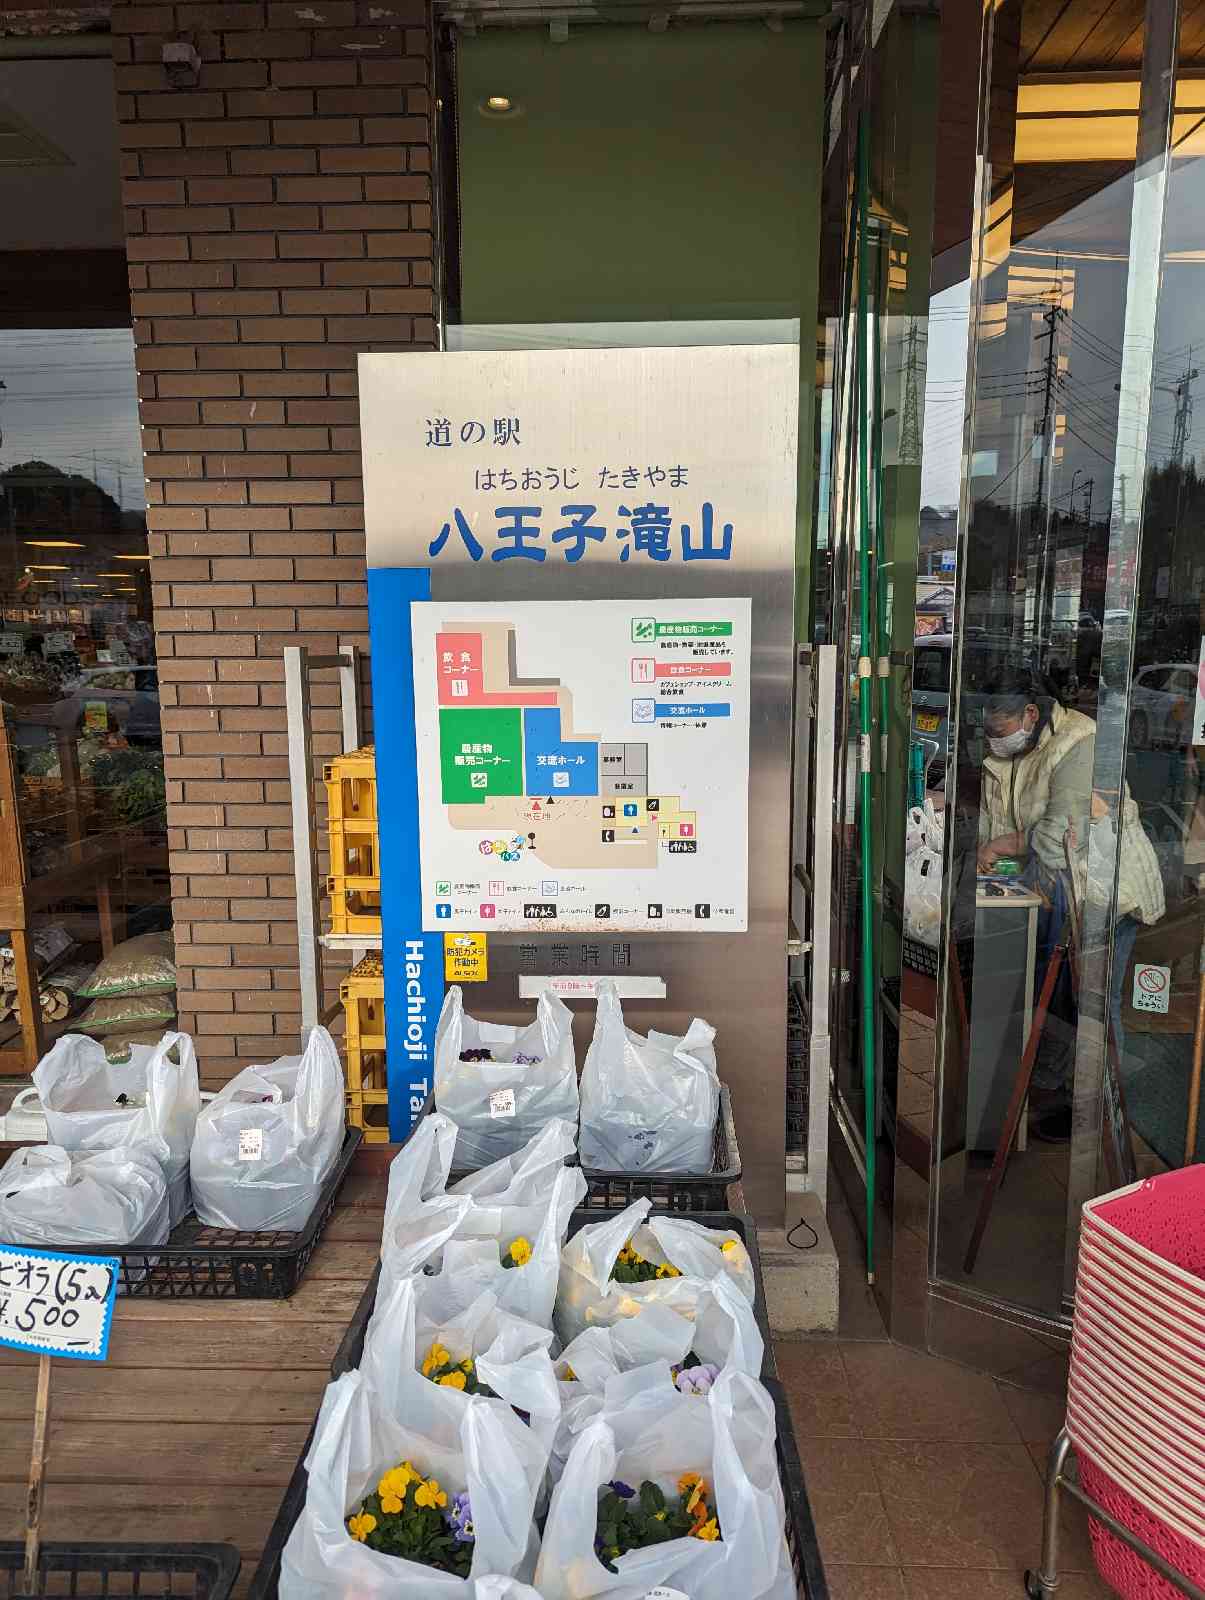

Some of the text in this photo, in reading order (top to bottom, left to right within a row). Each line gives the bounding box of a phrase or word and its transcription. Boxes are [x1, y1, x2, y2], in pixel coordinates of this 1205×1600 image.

[424, 417, 521, 448] 道の駅
[475, 464, 689, 491] はちおうじ たきやま
[428, 502, 734, 562] 八王子滝山
[443, 664, 481, 674] コーナー
[536, 755, 585, 766] 交流ホール
[447, 947, 485, 957] 防犯カメラ
[454, 957, 479, 967] 作動中
[519, 943, 631, 968] 営業時間
[404, 940, 428, 1061] Hachioji
